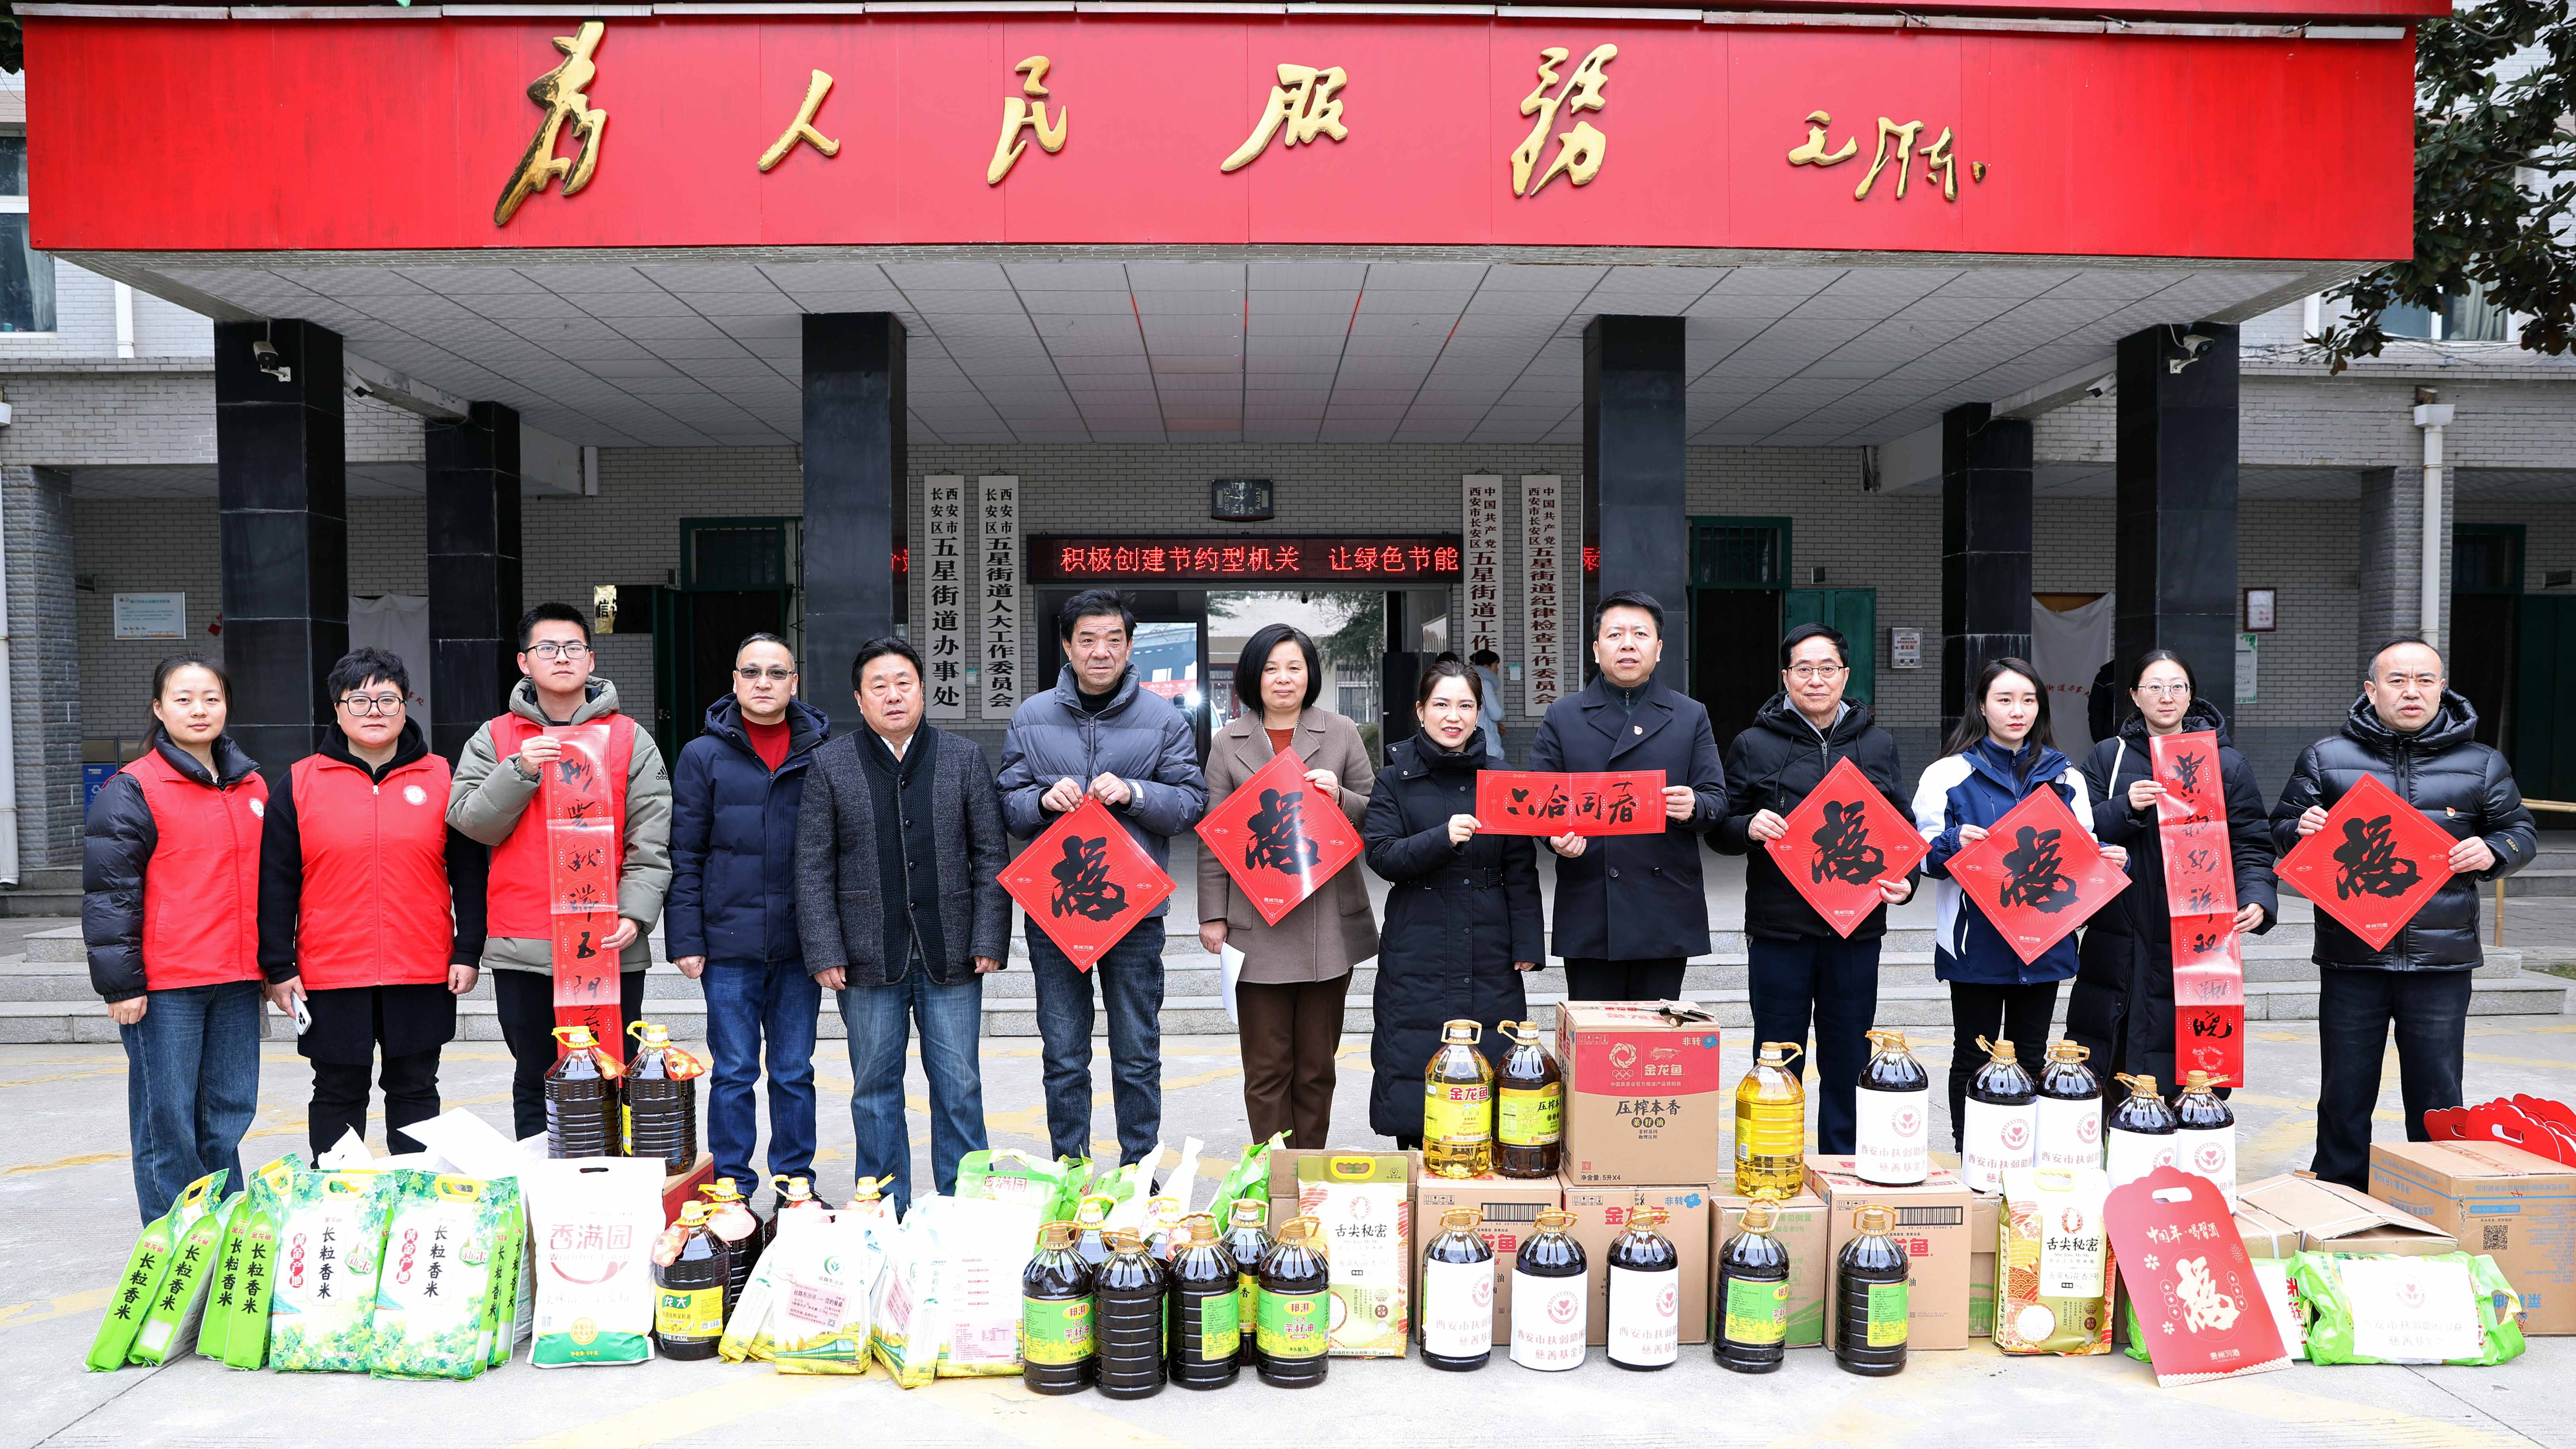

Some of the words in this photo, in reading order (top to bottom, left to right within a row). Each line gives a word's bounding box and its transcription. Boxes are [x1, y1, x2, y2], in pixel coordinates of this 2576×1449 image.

[1469, 486, 1482, 549] 西安市长安区
[1484, 486, 1497, 549] 中国共产党
[1528, 486, 1541, 545] 西安市长安区
[1543, 486, 1556, 545] 中国共产党
[1060, 545, 1300, 572] 积极创建节约型机关
[1328, 545, 1459, 572] 让绿色节能
[931, 537, 960, 707] 五星街道办事处
[985, 537, 1015, 708] 五星街道人大工作委员会
[1245, 788, 1322, 875] 福
[1811, 800, 1888, 886] 福
[2332, 814, 2424, 901] 福
[1051, 835, 1129, 922] 福
[2000, 825, 2081, 914] 福
[1681, 1036, 1701, 1047] 非转
[1449, 1086, 1488, 1101] 金龙鱼
[1644, 1064, 1683, 1076] 金龙鱼
[1614, 1099, 1682, 1117] 压榨本香
[1632, 1117, 1665, 1128] 菜籽油
[1664, 1196, 1684, 1206] 非转
[144, 1240, 165, 1254] 金龙鱼
[190, 1233, 209, 1246] 金龙鱼
[251, 1231, 271, 1241] 金龙鱼
[396, 1228, 420, 1285] 黄金产地
[461, 1249, 488, 1264] 新米
[550, 1223, 633, 1250] 香满园
[1334, 1223, 1387, 1238] 舌尖秘密
[2046, 1237, 2099, 1252] 舌尖秘密
[113, 1252, 155, 1321] 长粒香米
[159, 1244, 201, 1311] 长粒香米
[241, 1242, 267, 1314] 长粒香米
[289, 1232, 307, 1288] 黄金产地
[317, 1226, 336, 1300] 长粒香米
[347, 1252, 372, 1272] 新米
[423, 1225, 448, 1298] 长粒香米
[488, 1244, 505, 1317] 长粒香米
[507, 1237, 521, 1309] 长粒香米
[665, 1295, 687, 1308] 龙大
[2176, 1256, 2241, 1334] 福
[1064, 1324, 1090, 1340] 菜籽油
[1284, 1323, 1315, 1333] 菜籽油
[1534, 1345, 1584, 1360] 慈善基金会
[2210, 1348, 2240, 1360] 贵州习酒
